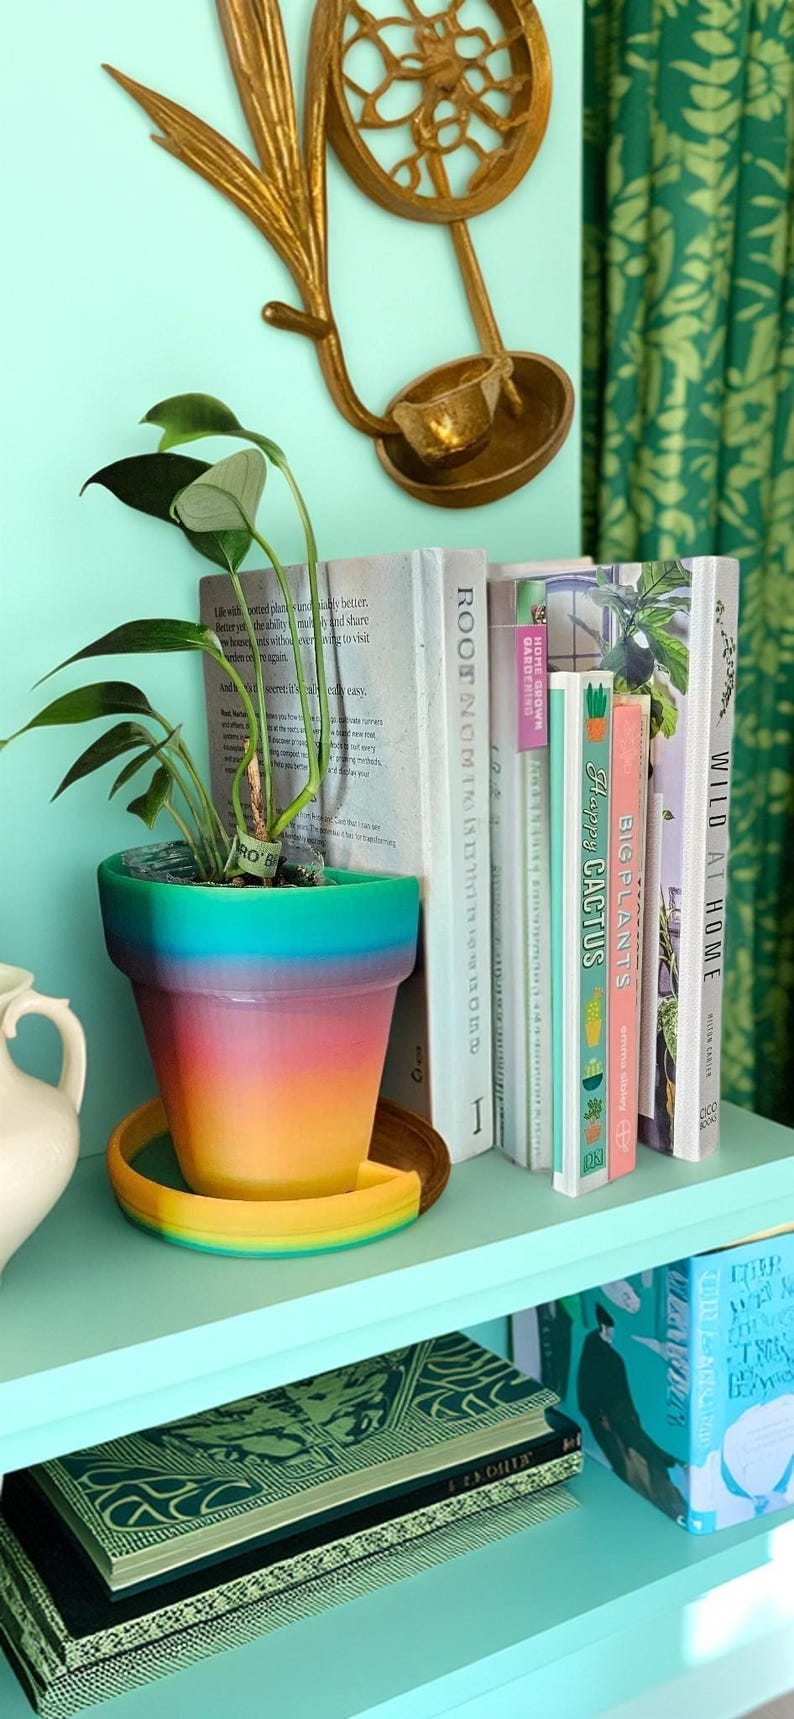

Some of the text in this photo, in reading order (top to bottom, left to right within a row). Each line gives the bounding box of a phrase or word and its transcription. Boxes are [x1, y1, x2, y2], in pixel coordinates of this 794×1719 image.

[215, 606, 226, 618] Life
[227, 604, 241, 616] with
[248, 602, 269, 616] potted
[341, 596, 369, 609] better.
[216, 622, 235, 633] Better
[253, 619, 265, 631] the
[265, 618, 287, 632] ability
[330, 614, 344, 627] and
[346, 613, 369, 627] share
[270, 634, 293, 647] withou
[343, 634, 351, 644] to
[352, 631, 370, 644] visit
[224, 651, 245, 663] arden
[267, 651, 288, 665] again.
[533, 636, 543, 675] HOME
[220, 681, 232, 692] And
[327, 683, 345, 699] eally
[347, 686, 367, 699] easy.
[582, 760, 608, 969] Happy CACTUS
[703, 751, 729, 982] WILD AT HOME
[616, 815, 633, 989] BIG PLANTS
[699, 1101, 718, 1120] CICO
